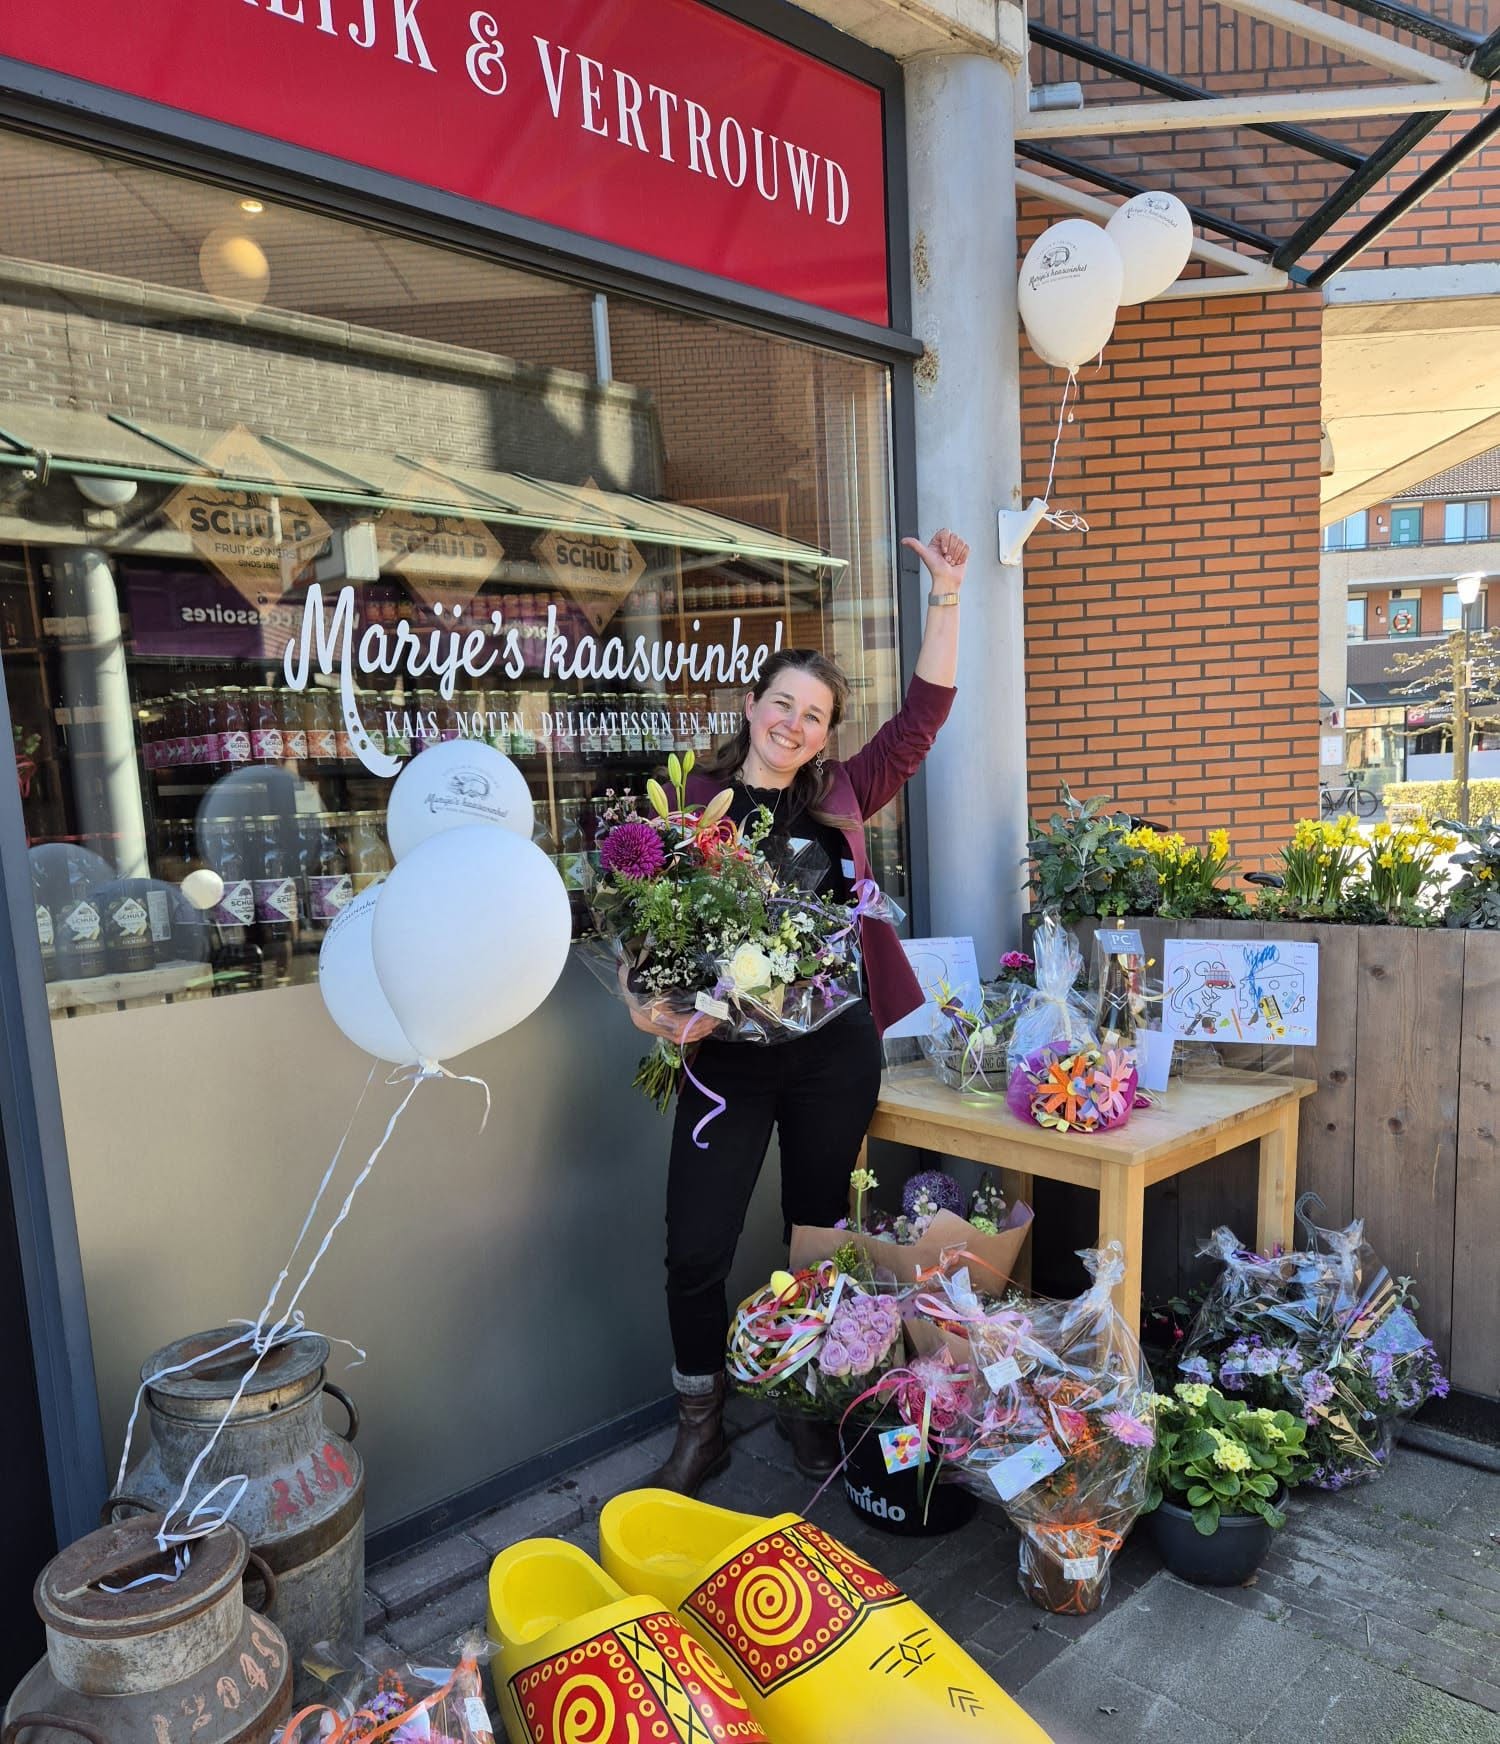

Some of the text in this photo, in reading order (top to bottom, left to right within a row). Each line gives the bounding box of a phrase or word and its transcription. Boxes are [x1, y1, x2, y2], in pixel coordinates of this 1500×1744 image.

[465, 10, 507, 96] &
[532, 35, 850, 226] VERTROUWD
[189, 507, 311, 542] SCHULP
[556, 544, 632, 574] SCHULP
[283, 583, 525, 778] Marije's
[385, 711, 447, 739] KAAS,
[542, 711, 671, 737] DELICATESSEN
[680, 711, 699, 736] EN
[707, 711, 743, 736] MEE
